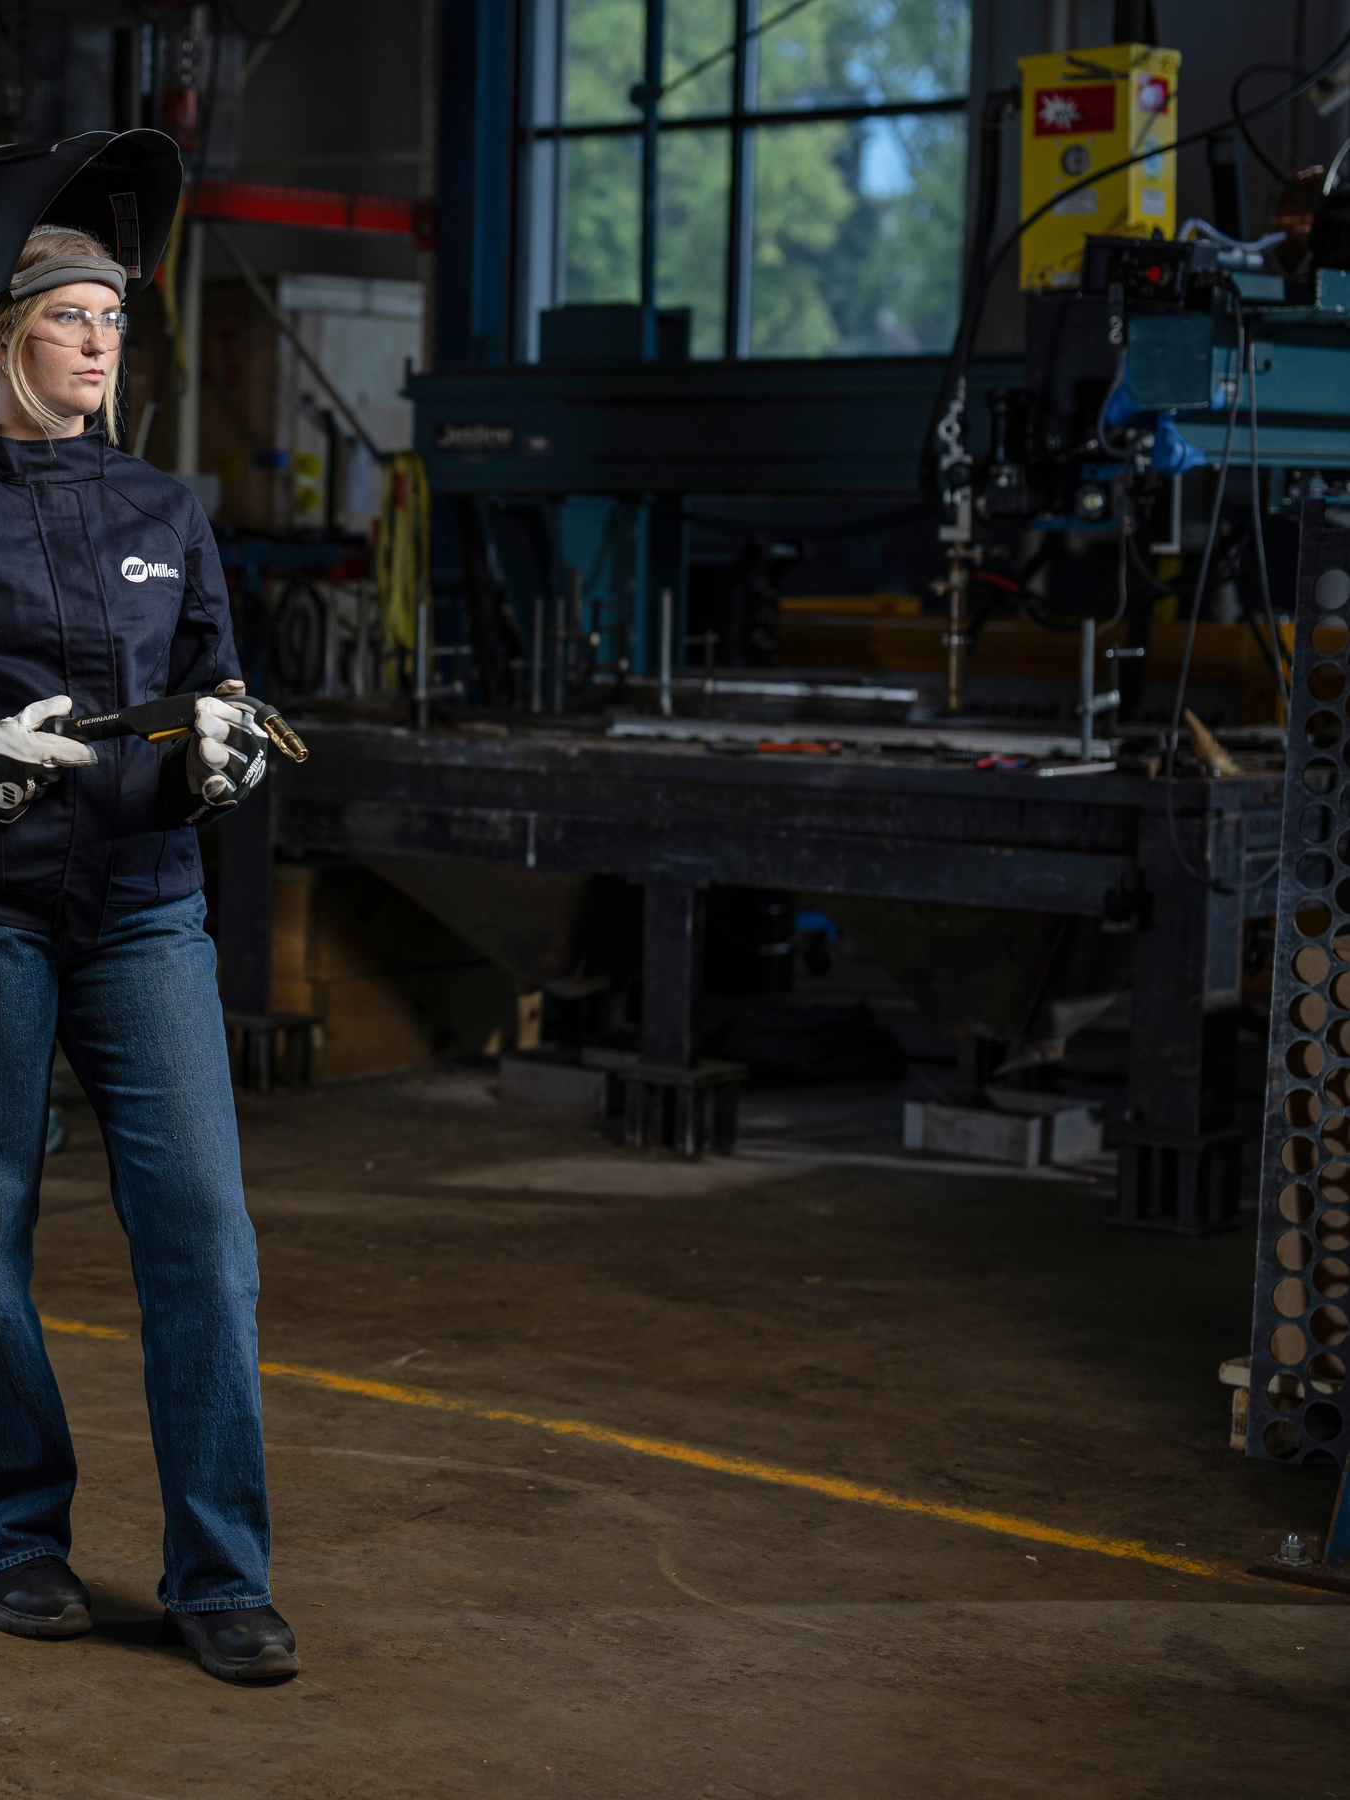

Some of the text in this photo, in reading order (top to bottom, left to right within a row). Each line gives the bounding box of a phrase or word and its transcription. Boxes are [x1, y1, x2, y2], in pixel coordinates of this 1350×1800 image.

[147, 562, 179, 578] Miller
[81, 713, 120, 725] BERNARD
[243, 748, 264, 784] Miller
